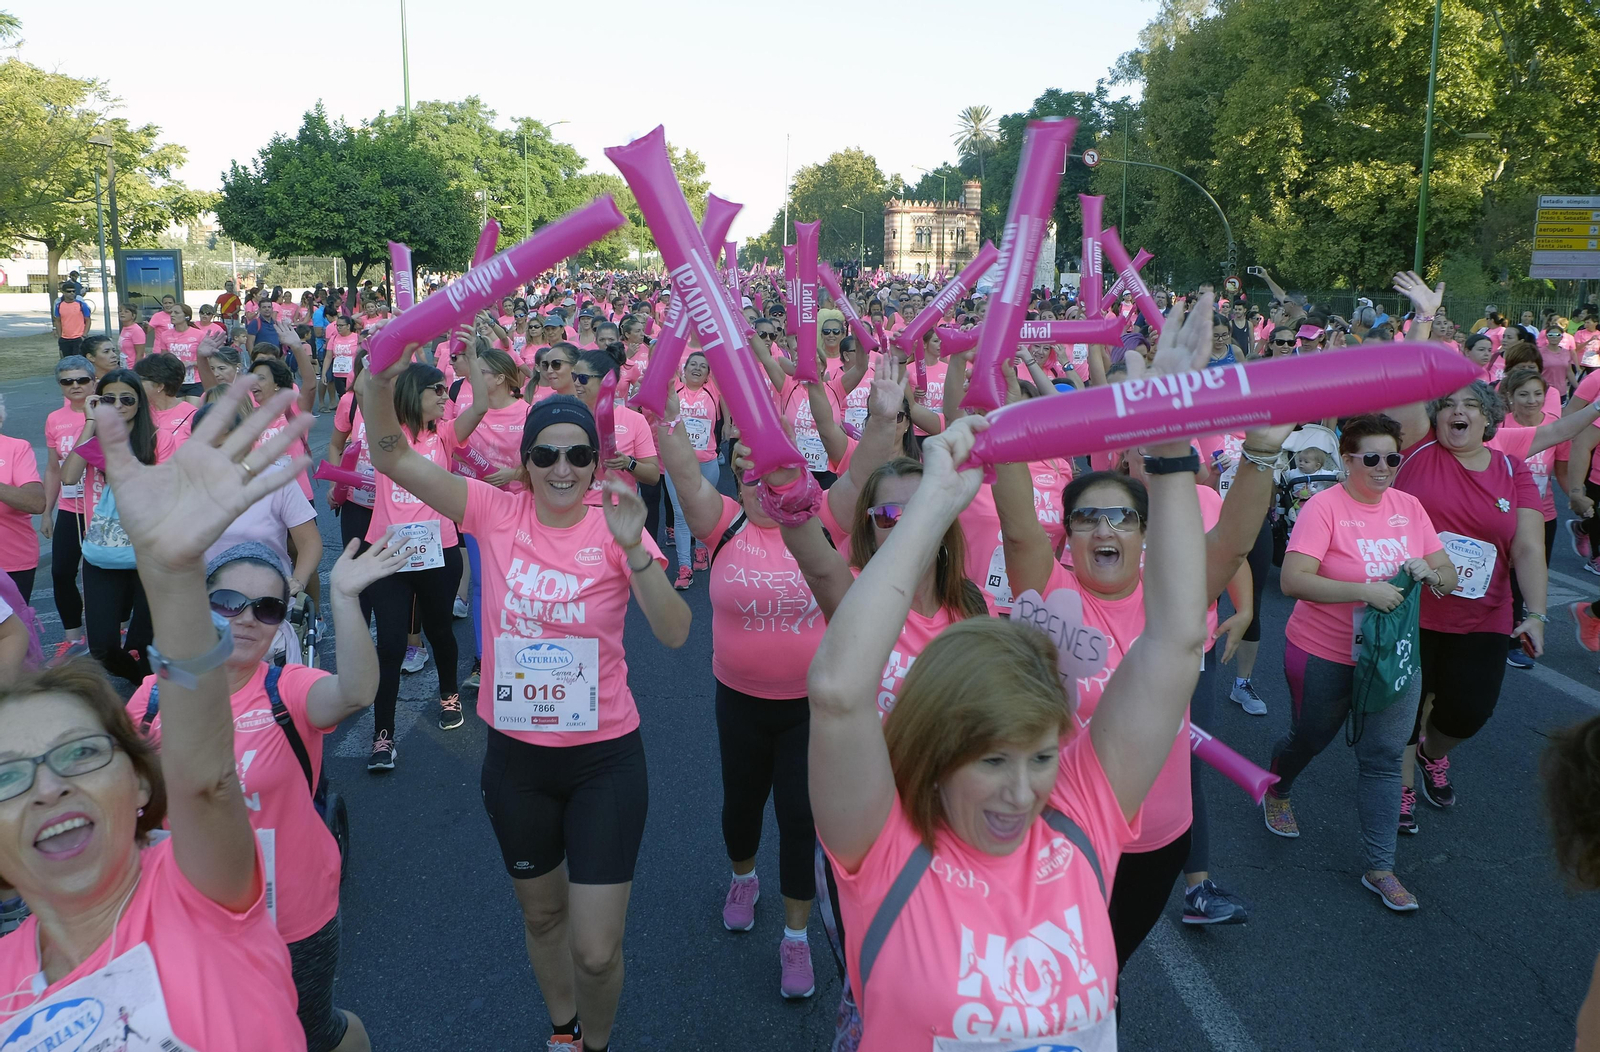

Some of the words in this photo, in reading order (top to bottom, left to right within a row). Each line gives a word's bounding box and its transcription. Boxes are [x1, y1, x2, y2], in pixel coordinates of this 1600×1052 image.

[445, 253, 518, 313] Ladival
[670, 262, 725, 352] Ladival
[802, 283, 816, 323] Ladival
[1020, 322, 1051, 339] dival
[1111, 363, 1252, 419] Ladival
[1185, 418, 1211, 430] solar
[1214, 410, 1272, 426] Protección
[794, 428, 819, 438] CHICA
[1105, 425, 1167, 444] profundidad
[1169, 424, 1183, 433] en
[804, 452, 820, 461] 016
[735, 539, 767, 559] OYSHO
[1356, 535, 1411, 562] HOY
[505, 557, 595, 602] HOY
[1456, 565, 1474, 578] 16
[775, 589, 789, 599] DE
[504, 590, 585, 624] GANAN
[735, 598, 808, 617] MUJER
[501, 608, 544, 638] LAS
[742, 616, 790, 632] 2016
[520, 653, 569, 664] ASTURIANA
[551, 669, 572, 677] Carrera
[523, 684, 566, 701] 016
[533, 704, 555, 713] 7866
[499, 715, 527, 724] OYSHO
[957, 904, 1098, 1009] HOY
[953, 976, 1109, 1041] GANAN
